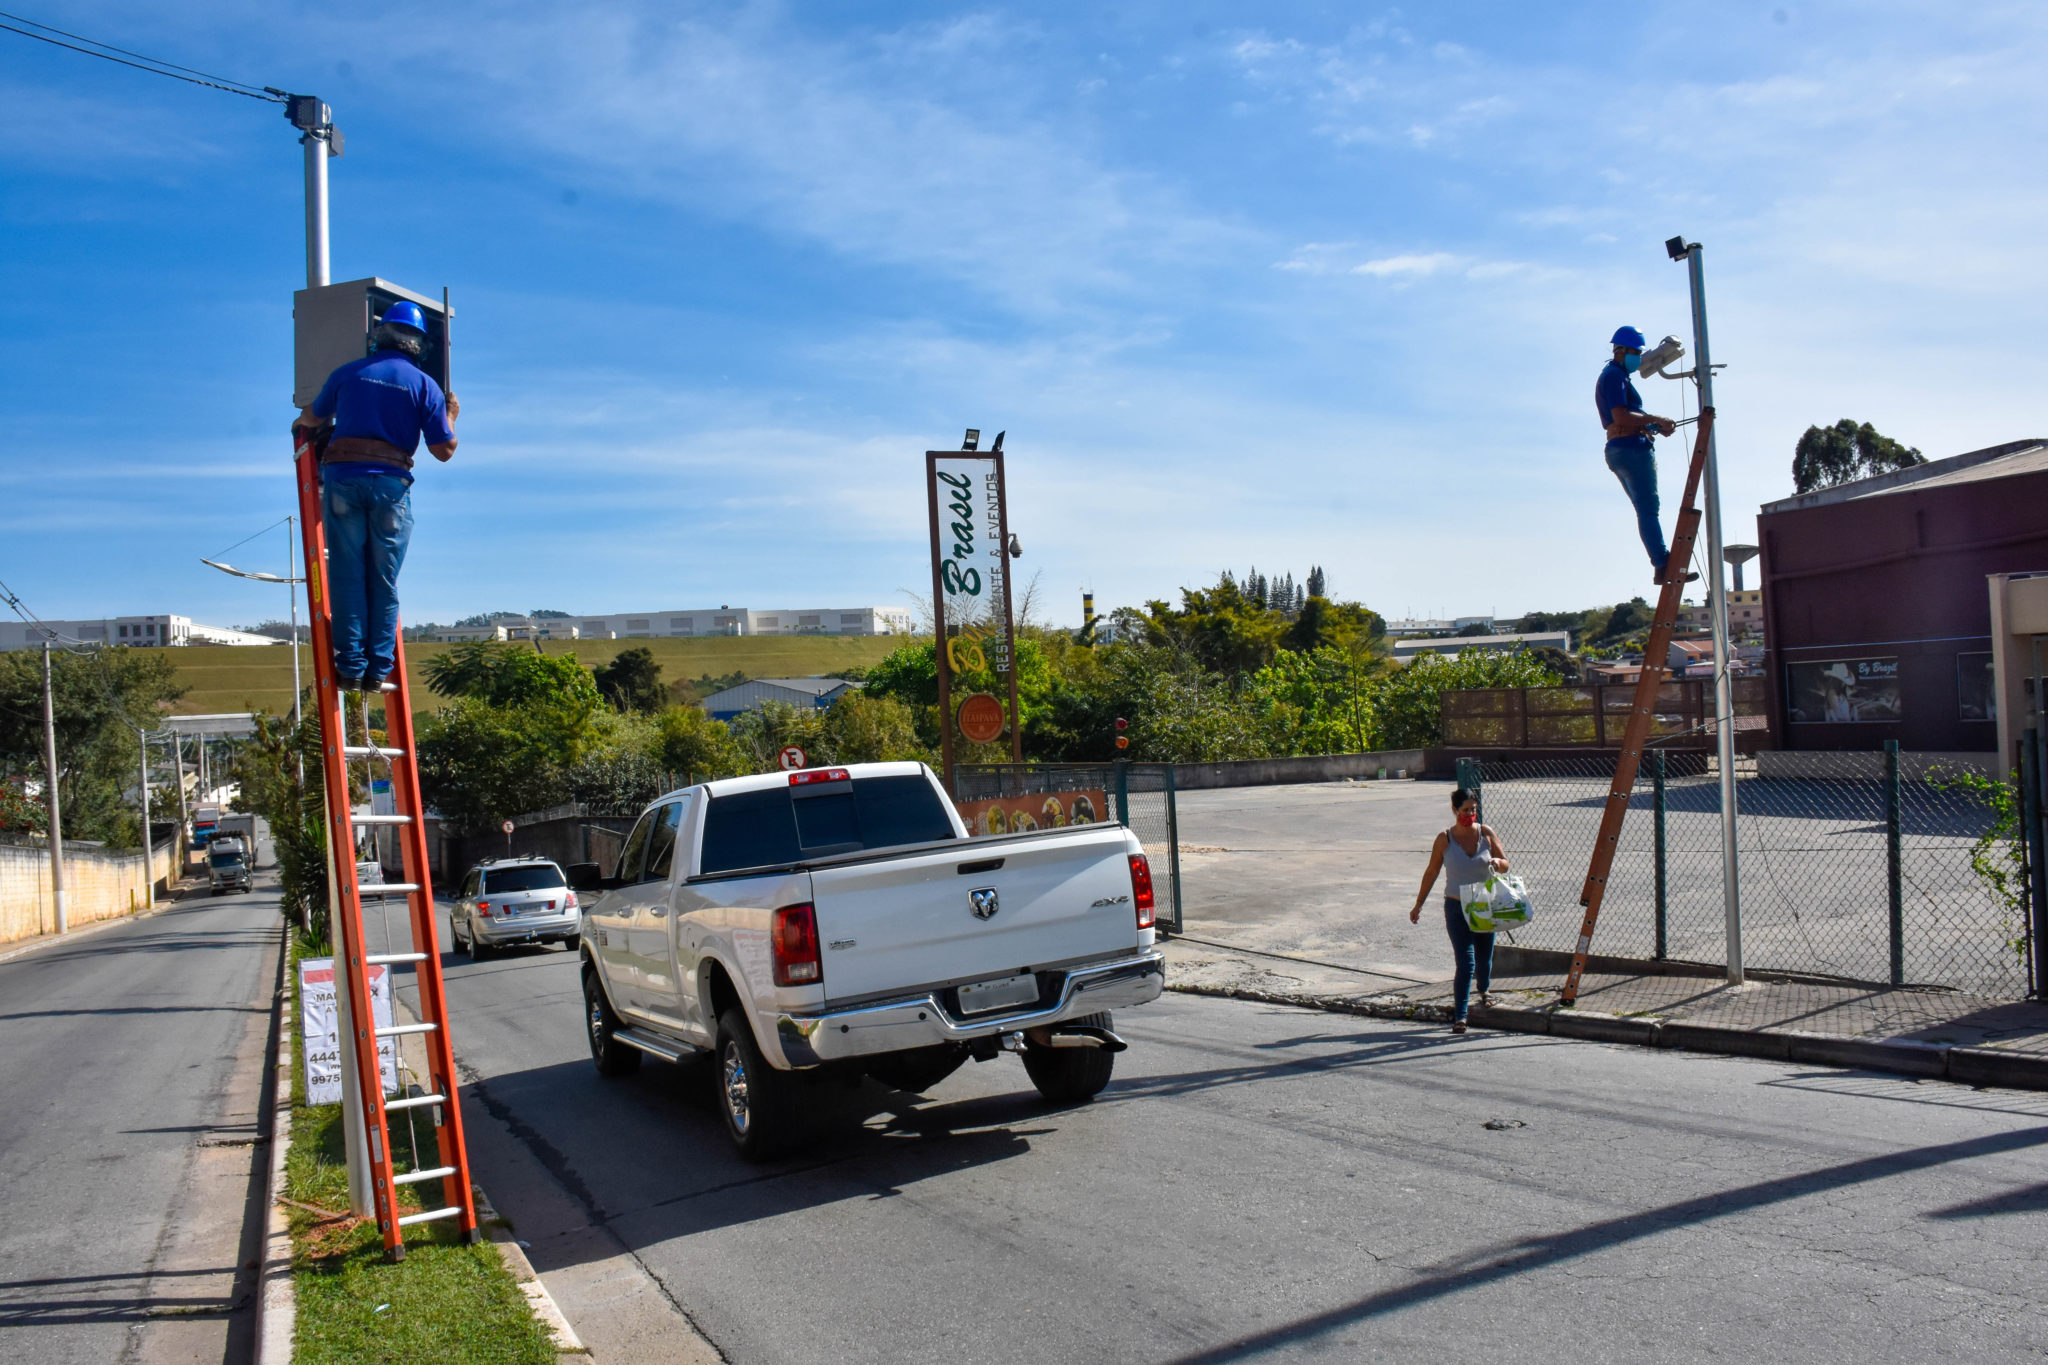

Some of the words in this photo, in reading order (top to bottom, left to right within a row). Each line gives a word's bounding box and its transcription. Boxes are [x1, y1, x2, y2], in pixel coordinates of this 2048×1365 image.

[985, 473, 1001, 540] EVENTOS
[989, 548, 1003, 558] &
[989, 566, 1010, 673] RESTAURANTE
[946, 621, 997, 674] By
[1858, 662, 1871, 675] By
[963, 713, 1000, 723] ITAIPAVA
